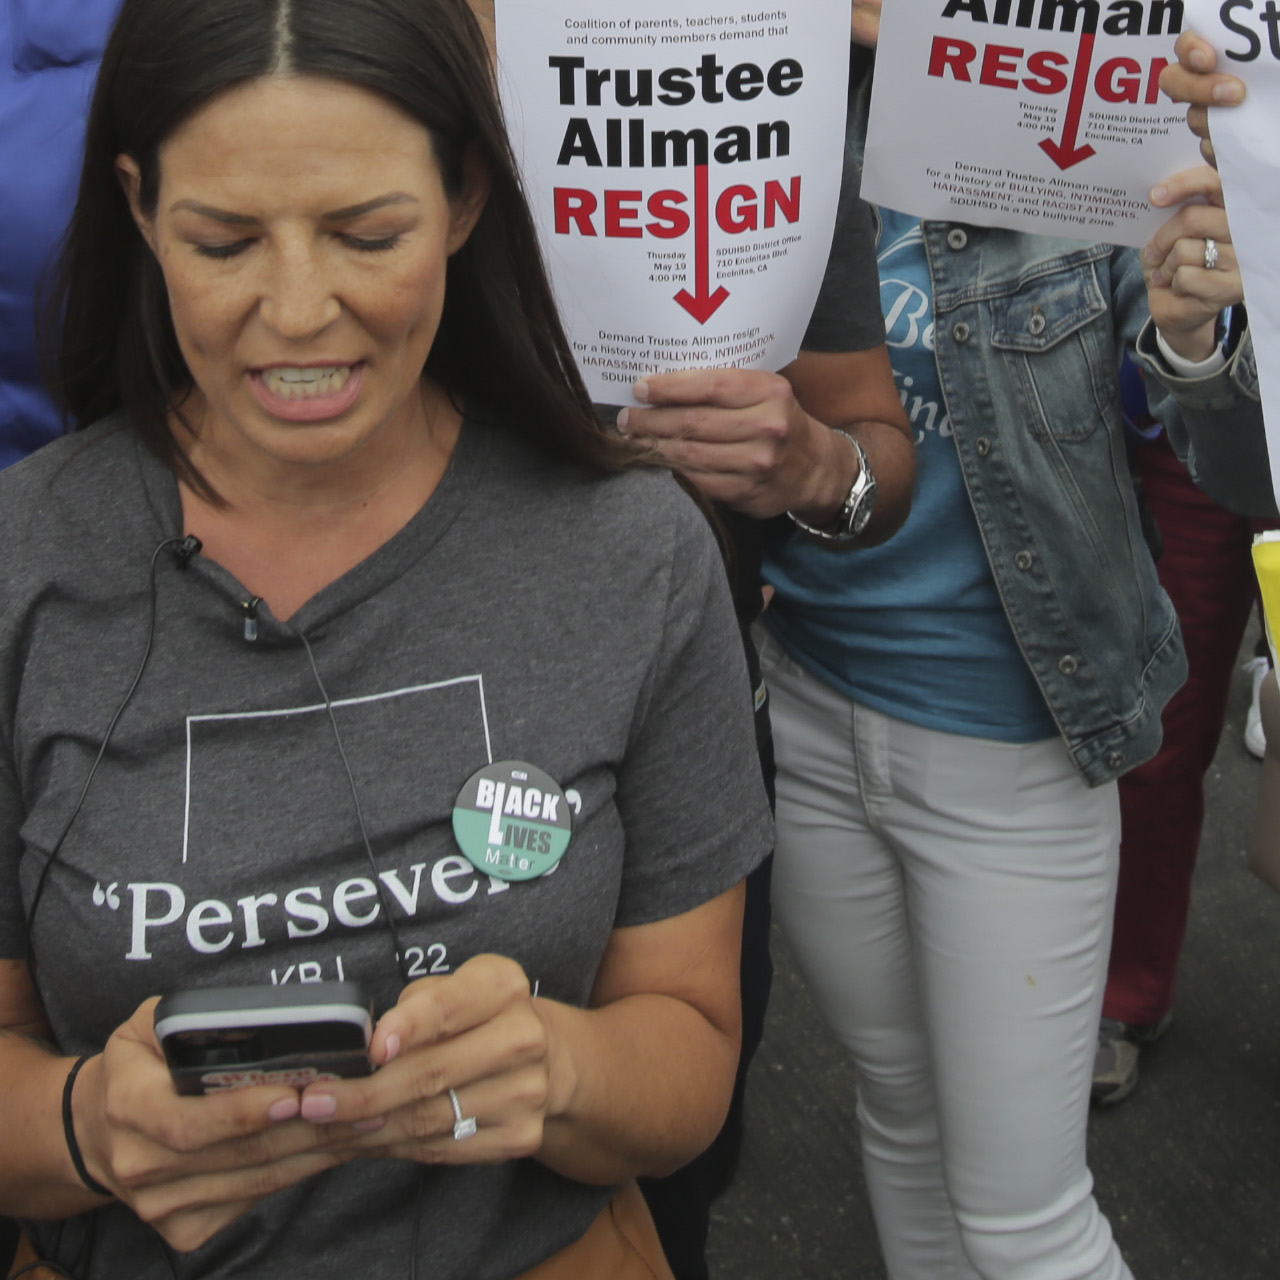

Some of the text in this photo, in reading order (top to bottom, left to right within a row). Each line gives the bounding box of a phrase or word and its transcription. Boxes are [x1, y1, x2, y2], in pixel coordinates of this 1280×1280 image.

[565, 10, 787, 30] Coalition of parents, teachers, students
[567, 26, 788, 47] and community members demand that
[548, 53, 804, 106] Trustee
[556, 117, 790, 167] Allman
[553, 175, 801, 240] RESIGN
